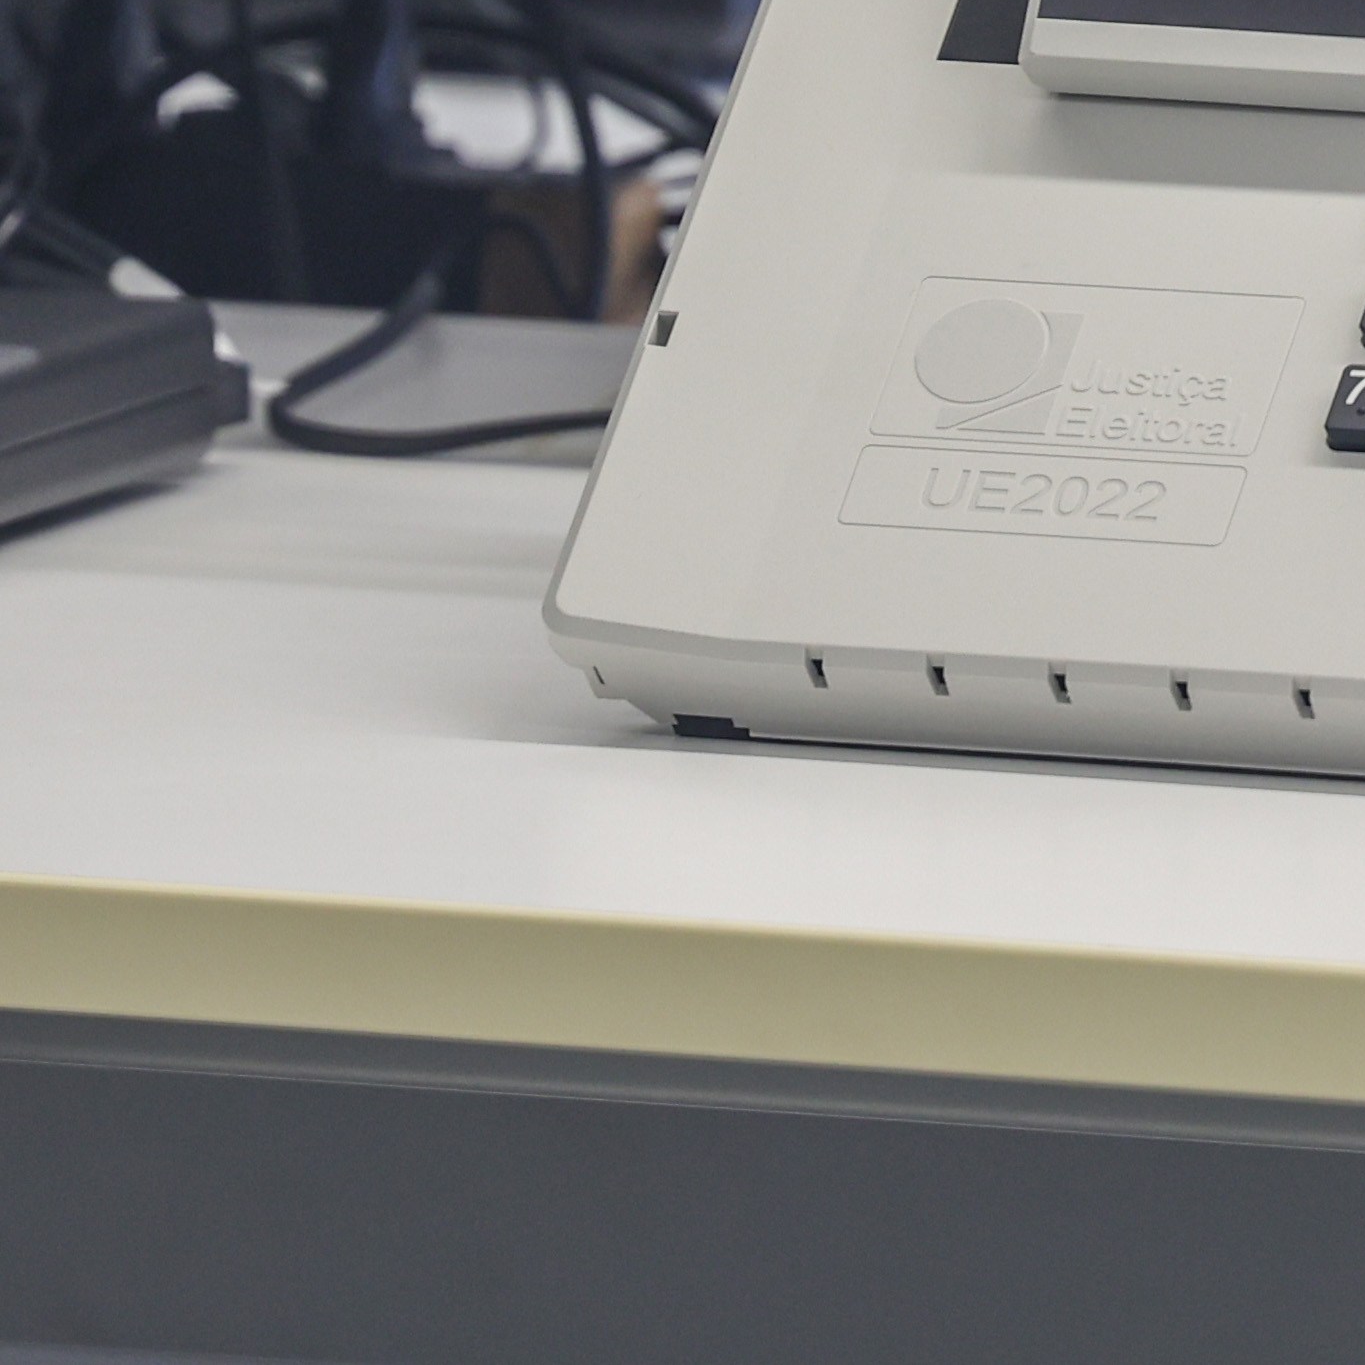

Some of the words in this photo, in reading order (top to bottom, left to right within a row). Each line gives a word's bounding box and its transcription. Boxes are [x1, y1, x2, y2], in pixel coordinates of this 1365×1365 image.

[1070, 359, 1229, 405] Justiça
[1057, 406, 1243, 447] Eleitoral
[921, 466, 1167, 522] UE2022
